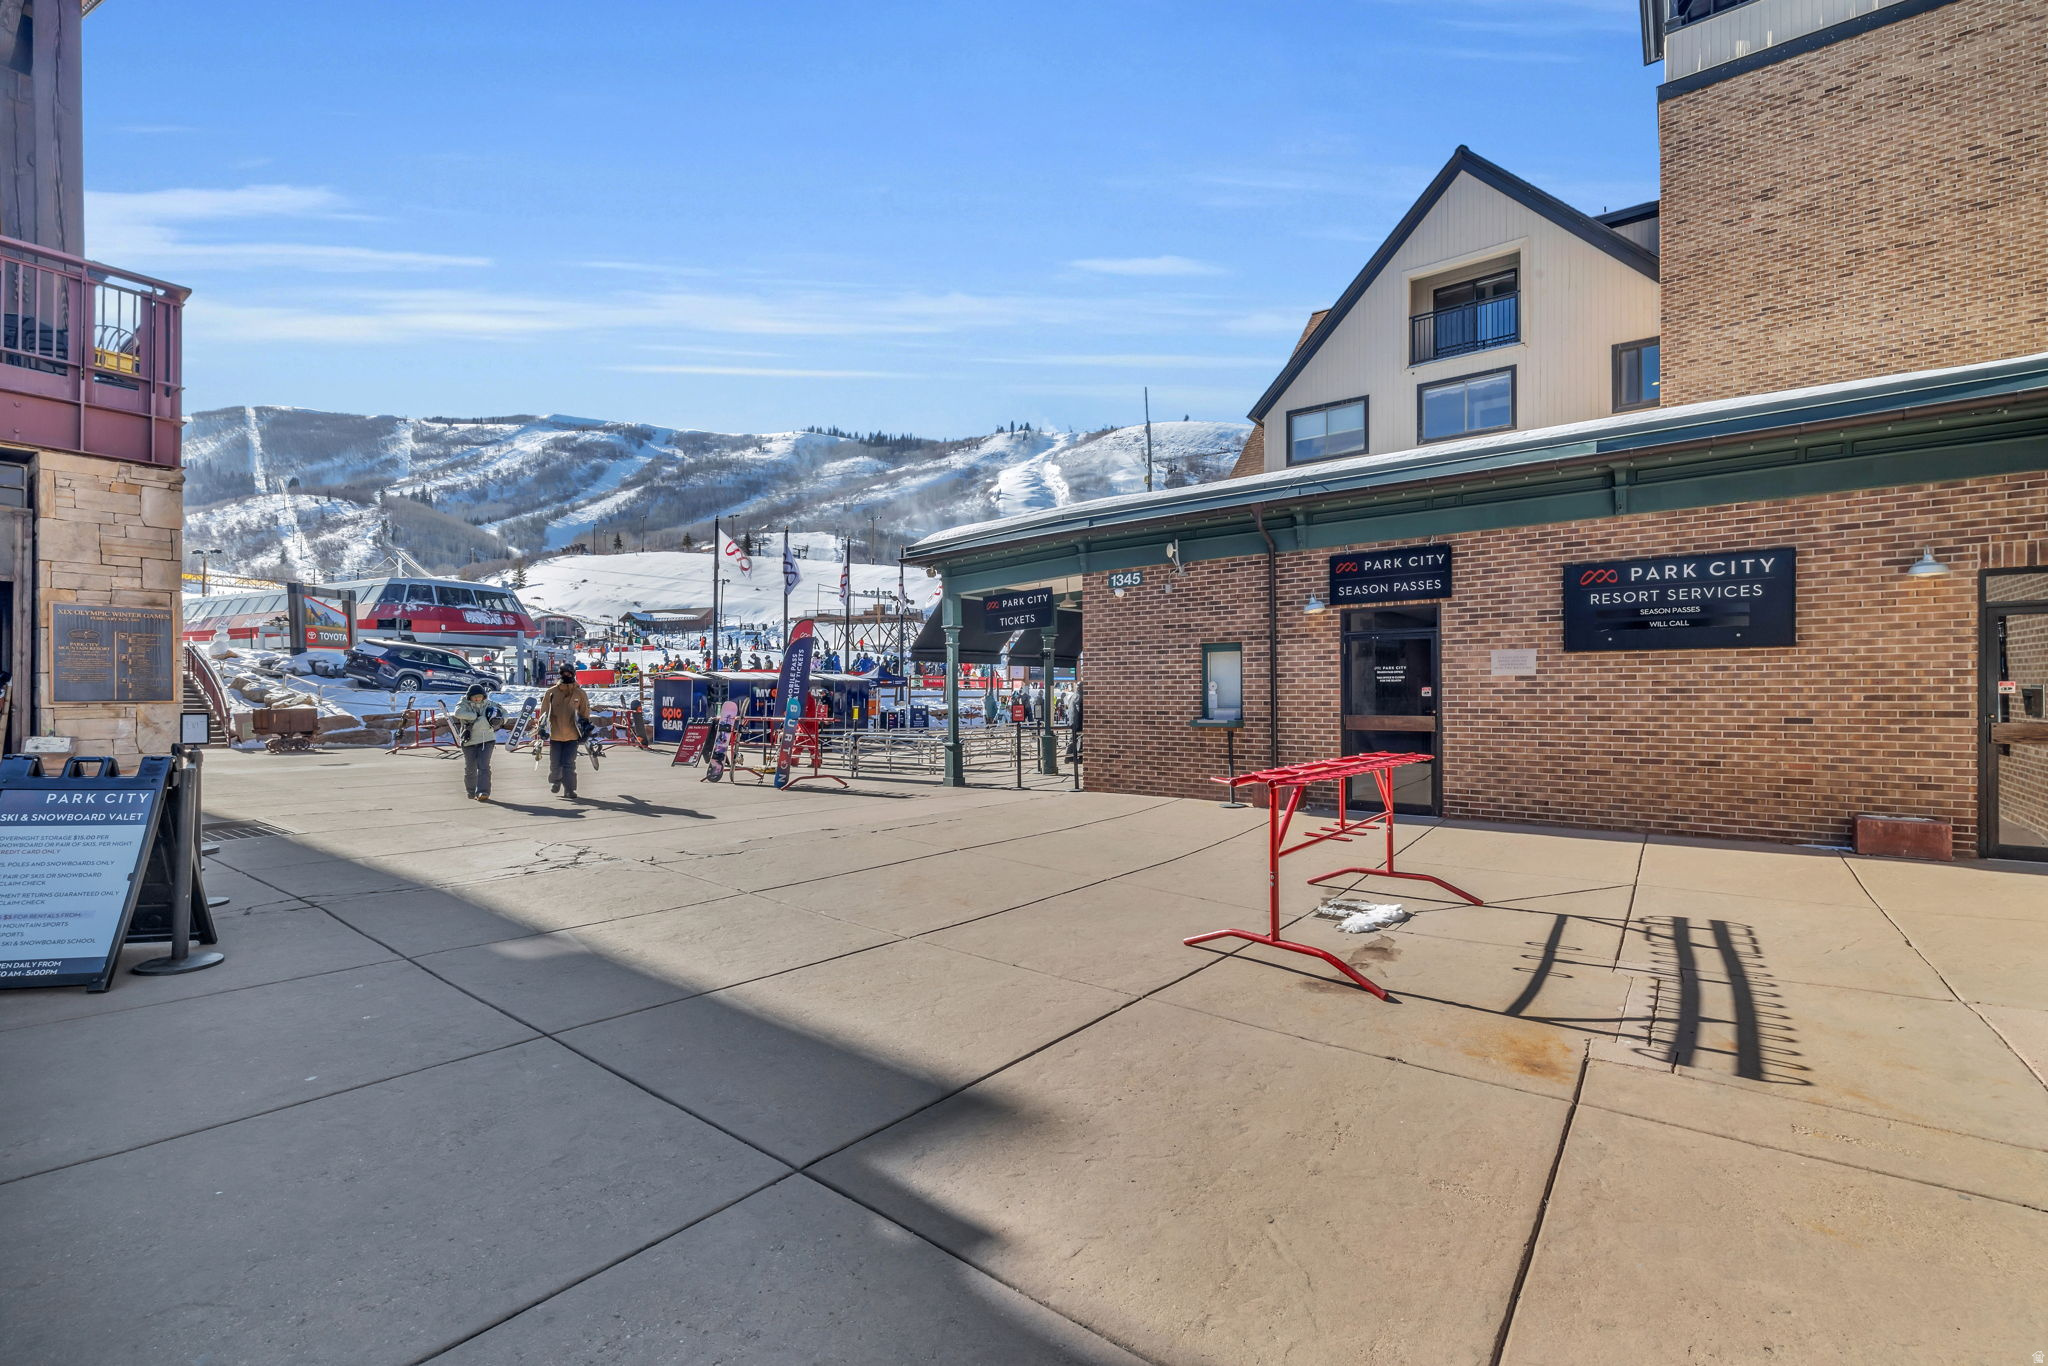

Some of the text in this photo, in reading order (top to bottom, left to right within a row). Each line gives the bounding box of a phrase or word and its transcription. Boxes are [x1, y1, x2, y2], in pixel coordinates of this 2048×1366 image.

[1364, 554, 1445, 571] PARK CITY
[1630, 557, 1776, 582] PARK CITY
[1110, 572, 1141, 587] 1345
[1338, 579, 1441, 596] SEASON PASSES
[1002, 594, 1048, 608] PARK CITY
[1590, 584, 1763, 605] RESORT SERVICES
[1640, 606, 1701, 615] SEASON PASSES
[1000, 613, 1036, 626] TICKETS
[1649, 619, 1690, 628] WILL CALL
[319, 632, 348, 642] TOYOTA
[790, 653, 798, 671] PASS
[795, 649, 805, 678] TICKETS
[793, 679, 801, 694] LIFT
[755, 689, 771, 698] MY
[662, 696, 675, 707] MY
[662, 708, 682, 720] epic
[510, 705, 532, 745] BURTON
[662, 720, 683, 731] GEAR
[777, 704, 798, 783] BURTON
[46, 793, 150, 804] PARK CITY
[0, 813, 144, 822] SKI & SNOWBOARD VALET
[37, 960, 62, 968] FROM
